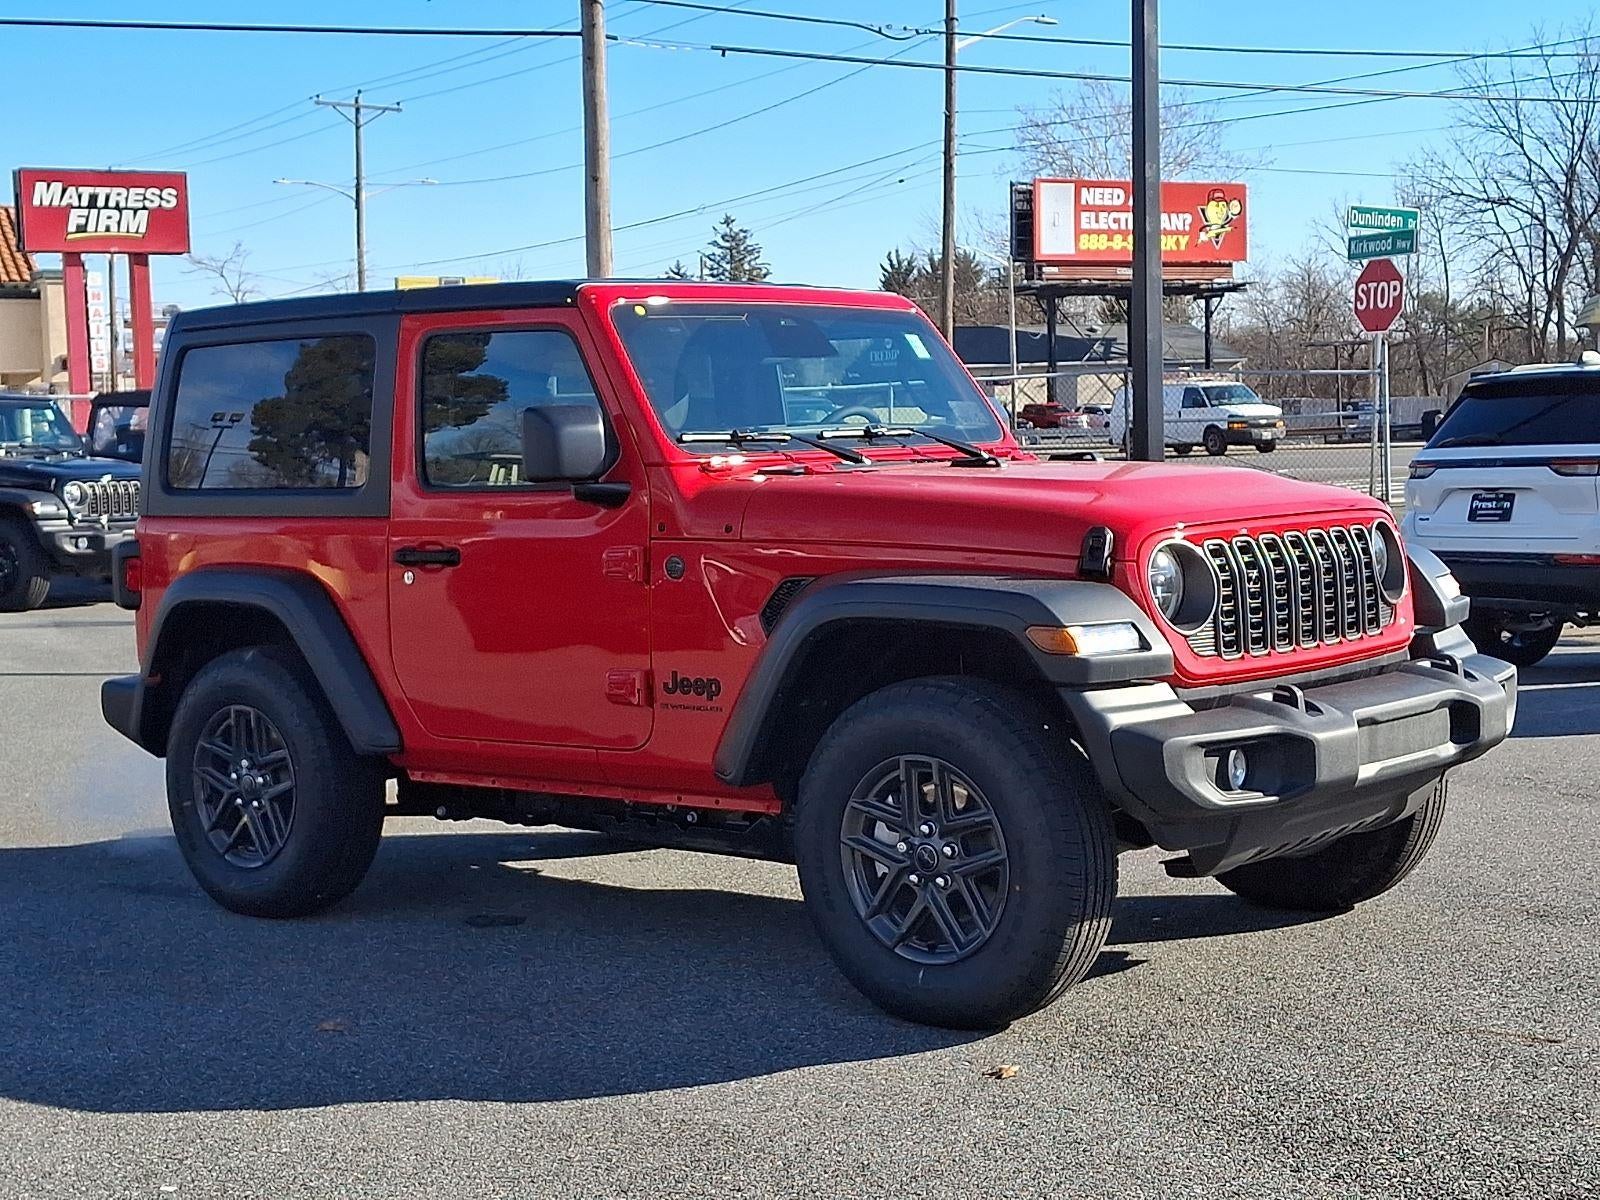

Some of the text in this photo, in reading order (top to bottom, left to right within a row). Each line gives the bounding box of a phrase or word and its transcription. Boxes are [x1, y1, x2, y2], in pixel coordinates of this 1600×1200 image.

[32, 181, 178, 208] MATTRESS
[1080, 187, 1125, 206] NEED
[67, 208, 149, 233] FIRM
[1351, 209, 1416, 229] Dunlinden Dr
[1350, 236, 1393, 254] Kirkwood
[1356, 280, 1400, 310] STOP
[662, 670, 721, 701] Jeep
